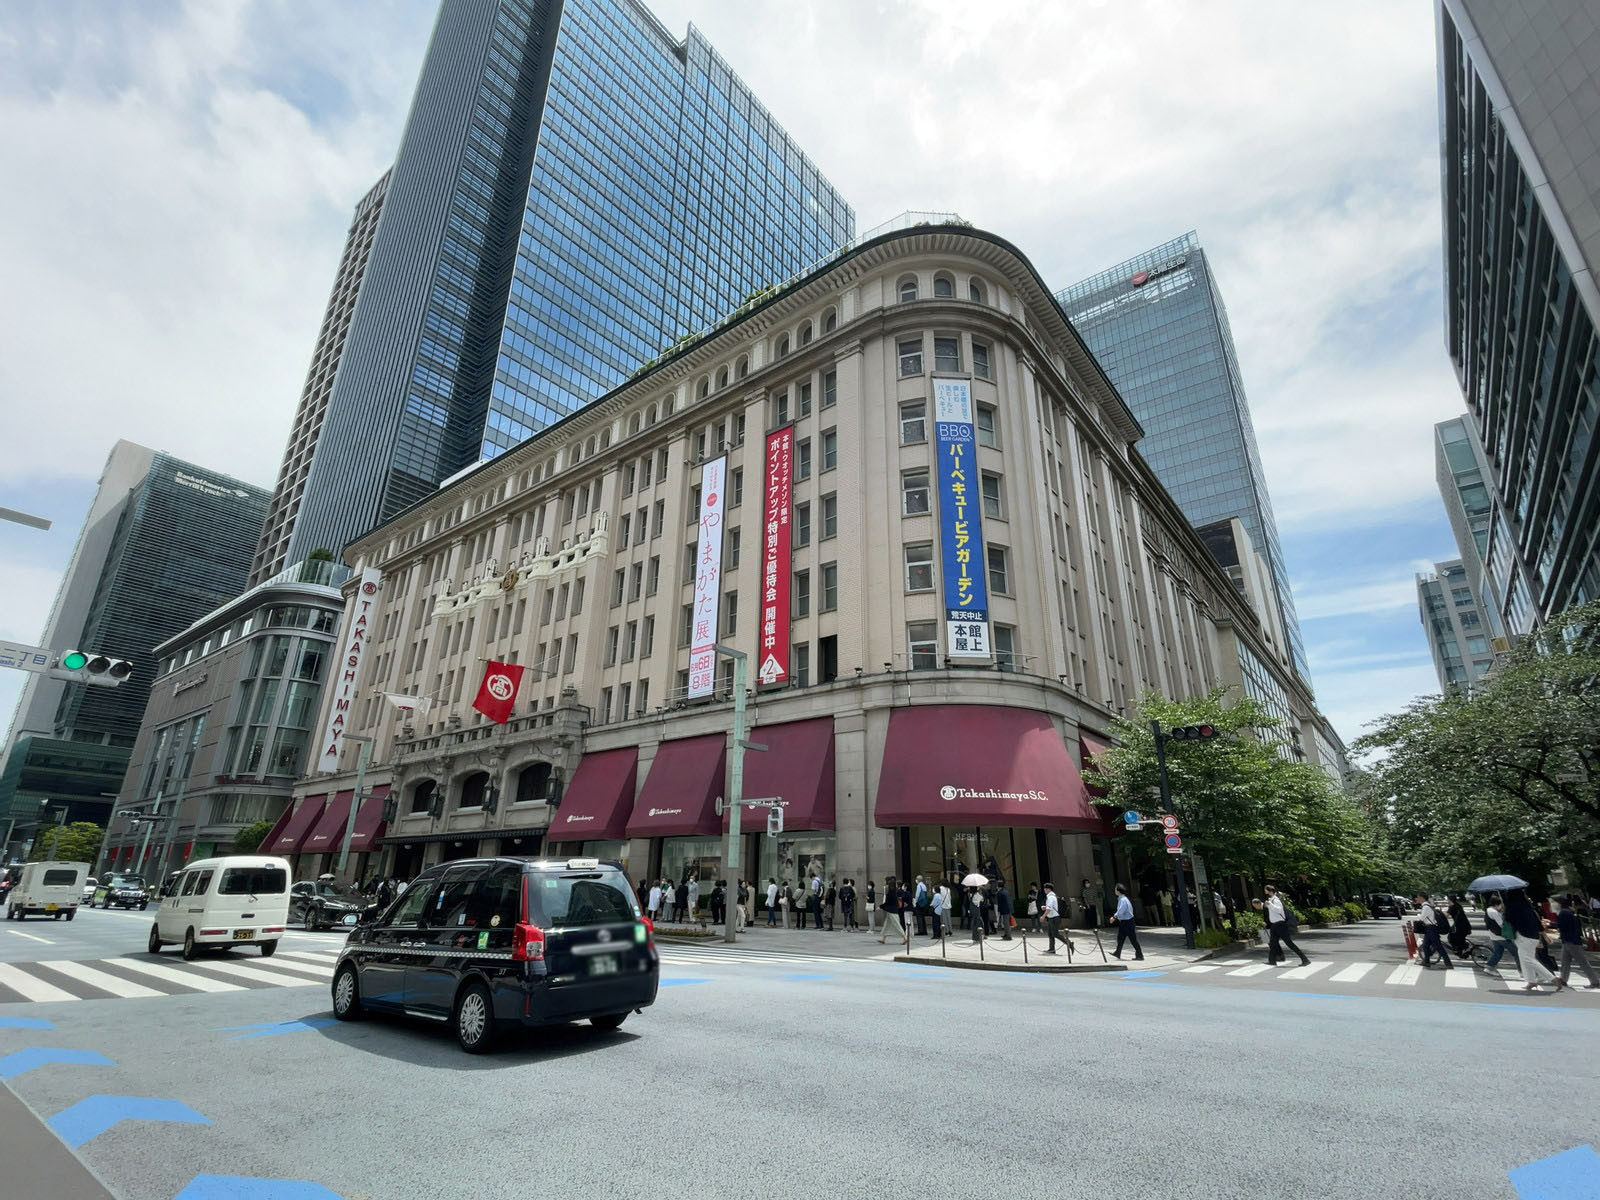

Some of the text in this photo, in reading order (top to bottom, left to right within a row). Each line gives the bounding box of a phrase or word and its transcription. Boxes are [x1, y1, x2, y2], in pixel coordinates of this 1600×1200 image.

[940, 424, 972, 440] BBQ
[949, 443, 973, 606] バーベキュービアガーデン
[764, 437, 781, 649] ポイントアップ特別ご優待会 開催中
[695, 512, 721, 641] やまがた展
[951, 611, 983, 620] 荒天中止
[954, 624, 981, 638] 本館
[955, 637, 983, 651] 屋上
[326, 600, 372, 757] TAKASHIMAYA
[956, 788, 1049, 802] Takashimaya S.C.
